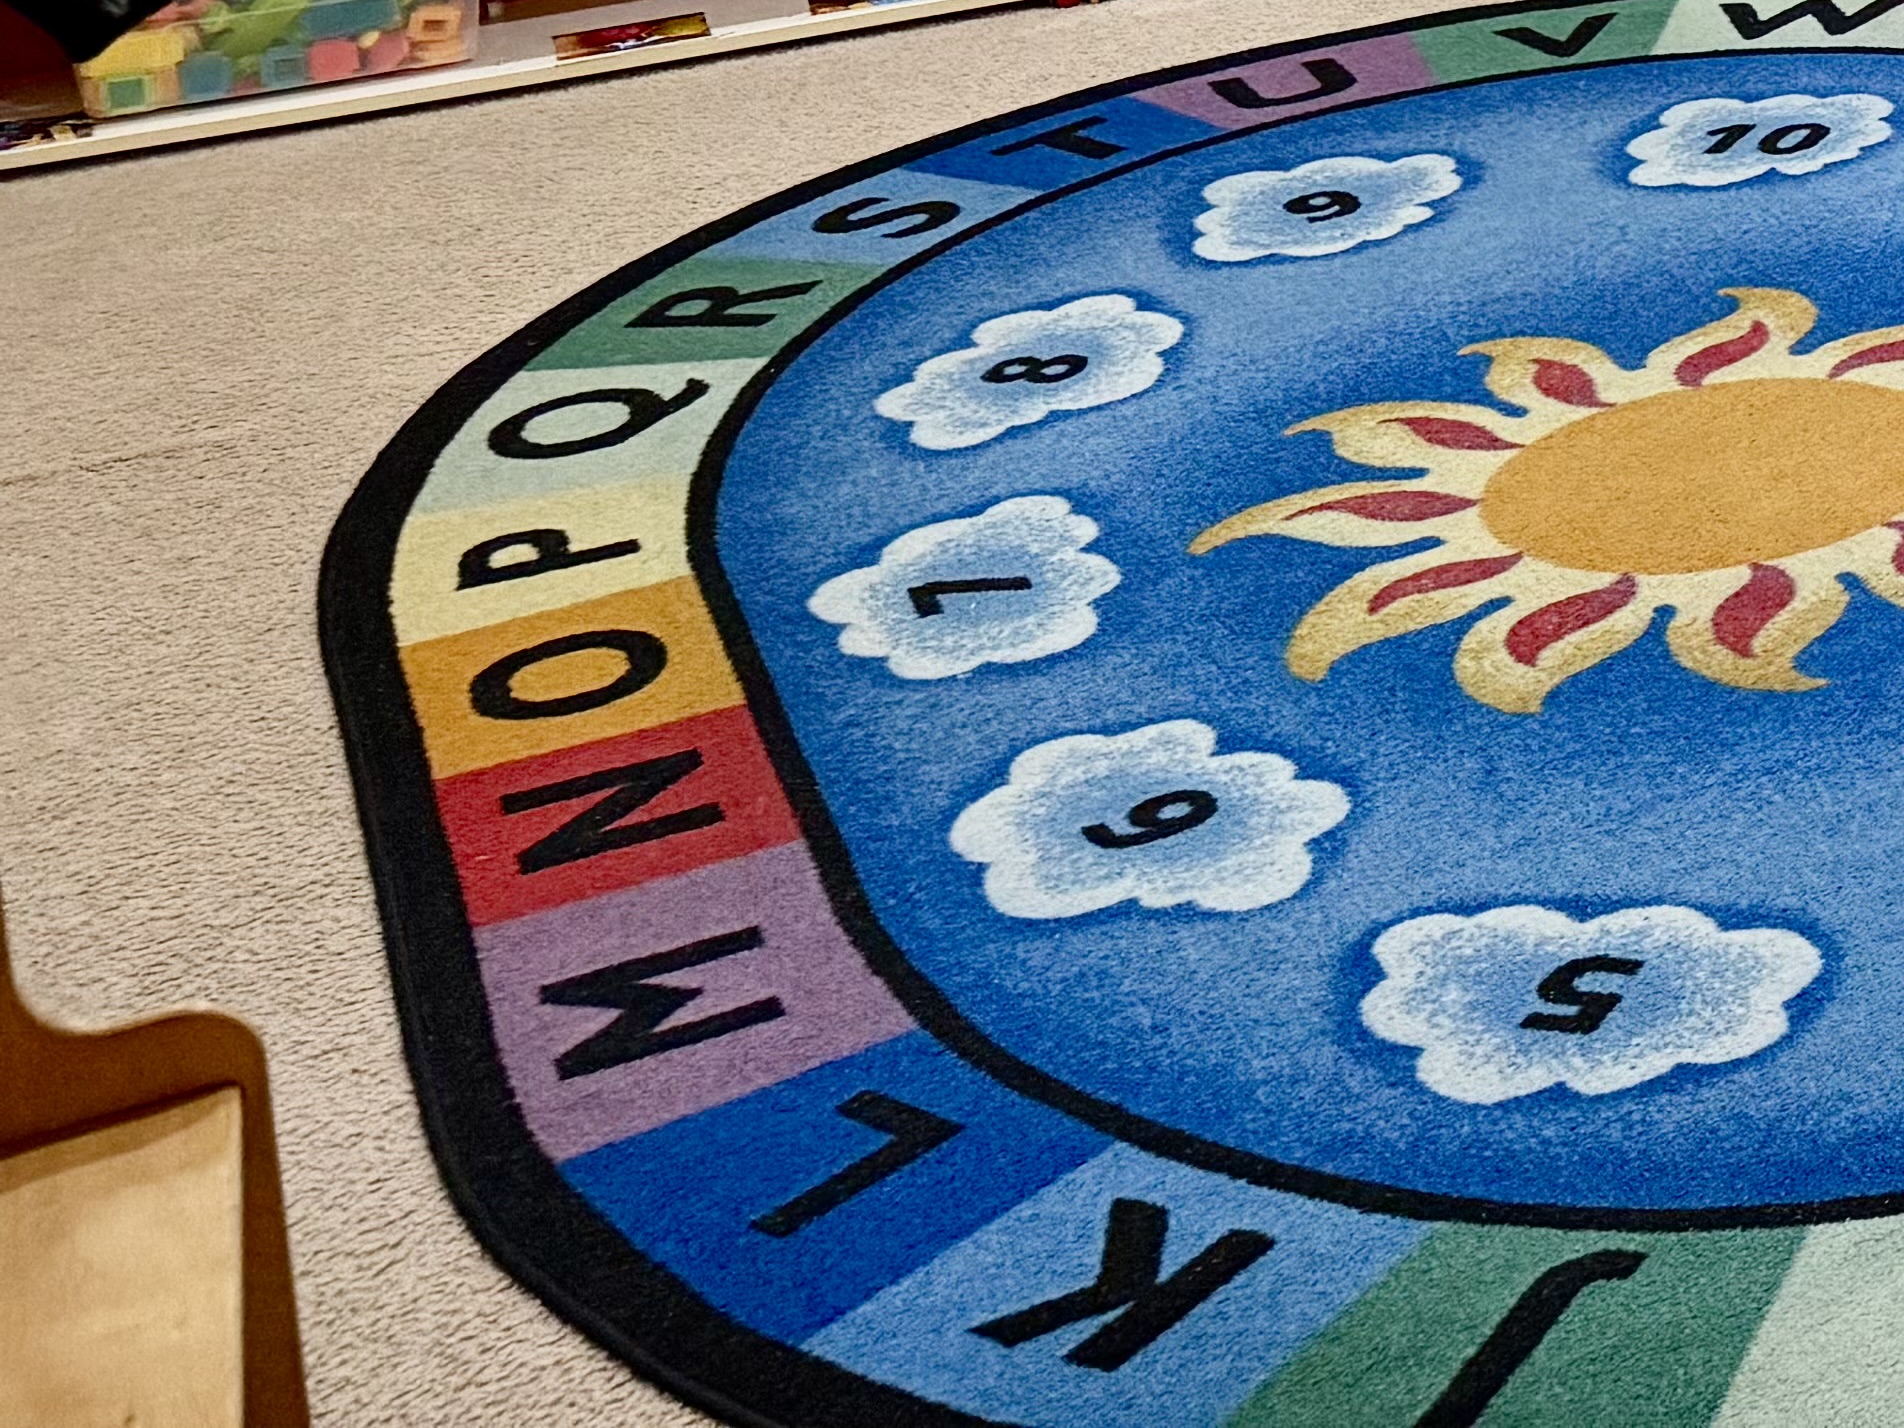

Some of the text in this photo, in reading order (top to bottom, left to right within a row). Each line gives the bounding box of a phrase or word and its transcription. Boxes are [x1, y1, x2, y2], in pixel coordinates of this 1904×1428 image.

[1493, 13, 1617, 57] V
[1208, 59, 1357, 109] U
[989, 115, 1137, 159] T
[1706, 124, 1829, 154] 10
[813, 198, 959, 238] S
[1284, 191, 1360, 222] 9
[624, 280, 822, 328] R
[982, 355, 1087, 383] 8
[488, 379, 709, 459] Q
[457, 529, 640, 590] P
[908, 578, 1031, 617] 7
[470, 630, 667, 720] O
[501, 749, 724, 875] N
[1083, 791, 1216, 848] 6
[539, 926, 786, 1081] M
[1521, 956, 1642, 1034] 5
[751, 1091, 962, 1238] L
[971, 1199, 1275, 1372] K
[1411, 1248, 1649, 1428] J
